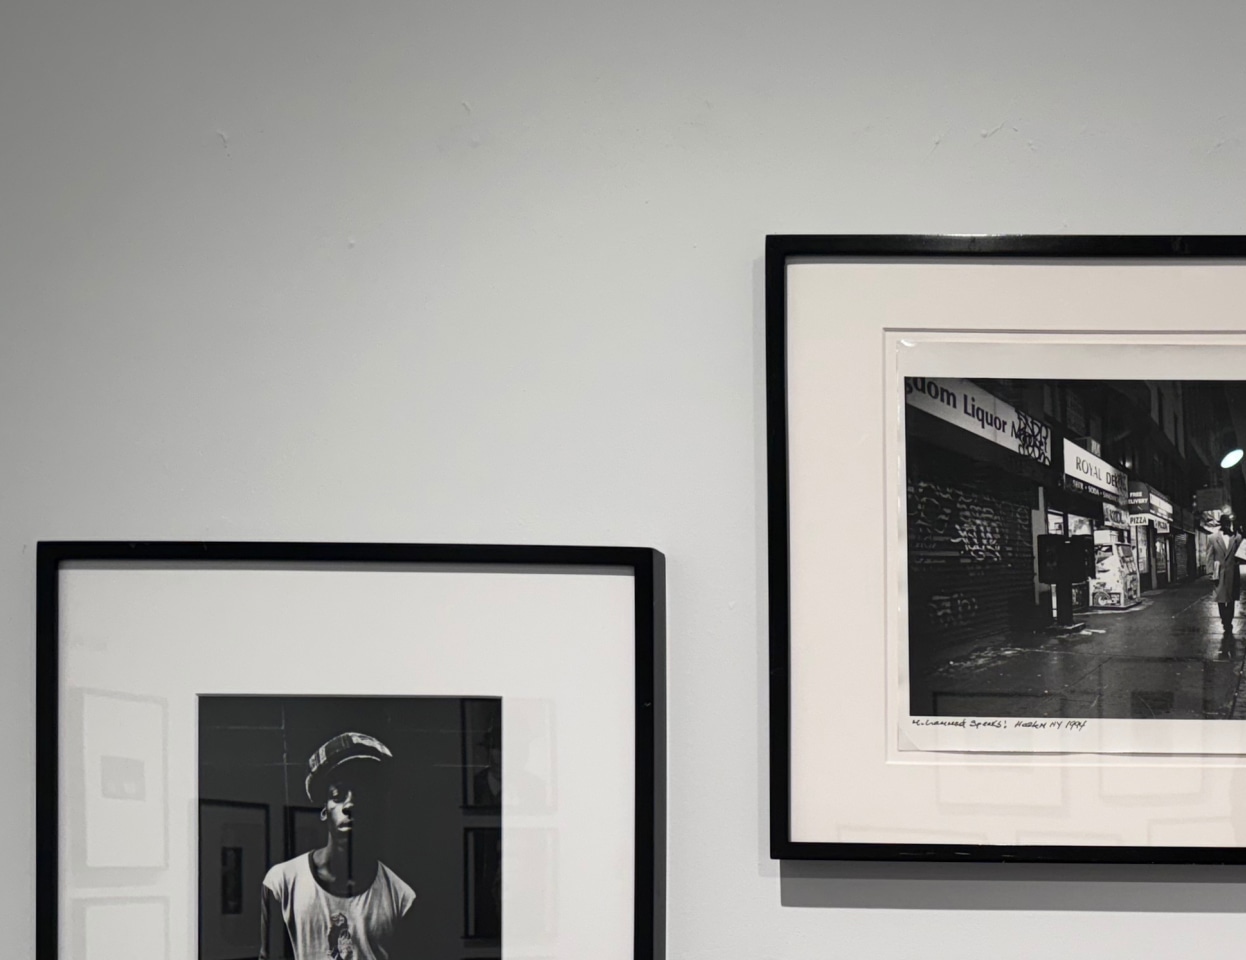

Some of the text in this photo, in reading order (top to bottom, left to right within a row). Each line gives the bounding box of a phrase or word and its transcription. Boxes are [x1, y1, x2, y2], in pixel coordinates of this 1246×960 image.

[963, 393, 1007, 433] Liquor
[1075, 456, 1102, 481] ROYAL
[1130, 516, 1147, 525] PIZZA
